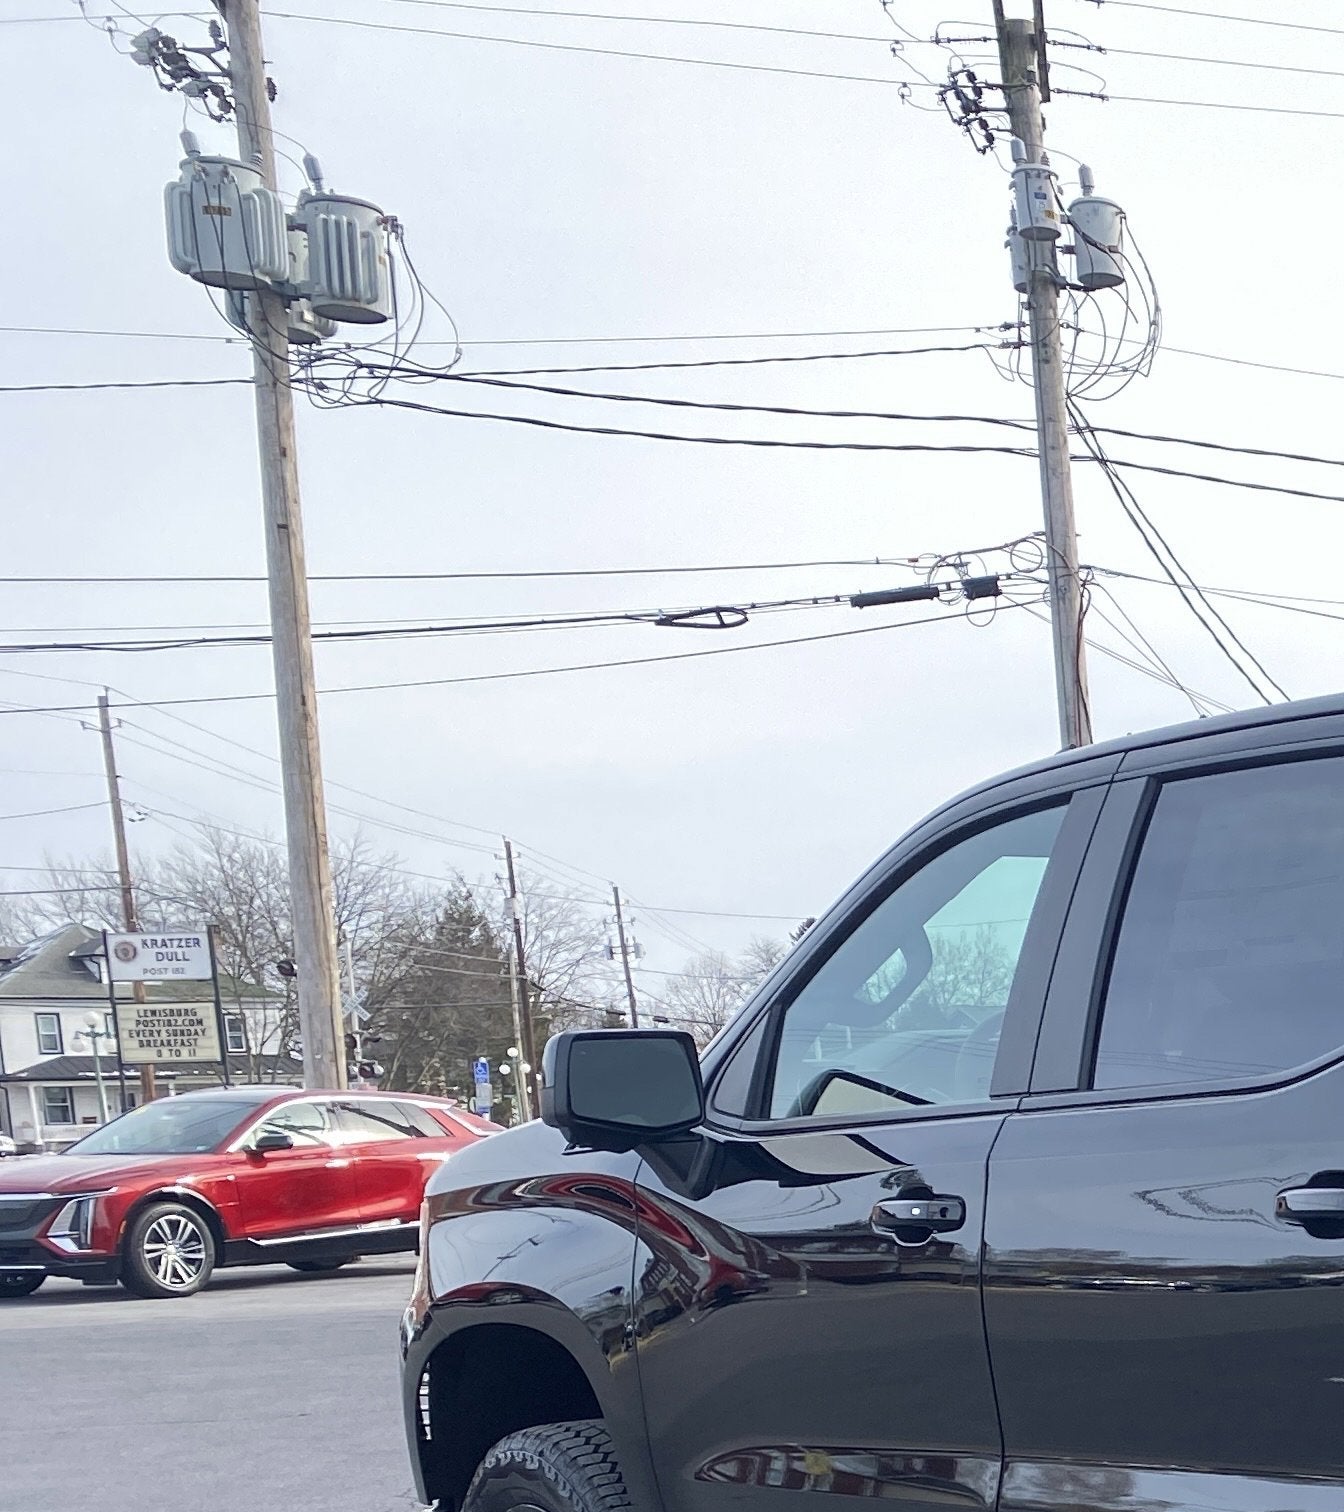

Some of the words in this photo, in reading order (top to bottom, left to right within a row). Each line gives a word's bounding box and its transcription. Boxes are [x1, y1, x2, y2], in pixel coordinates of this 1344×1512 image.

[141, 937, 202, 949] KRATZER
[155, 951, 190, 962] DULL
[142, 967, 169, 976] POST
[136, 1008, 198, 1018] LEWISBURG
[128, 1029, 162, 1039] EVERY
[165, 1027, 207, 1038] SUNDAY
[138, 1038, 199, 1048] BREAKFAST
[168, 1048, 182, 1058] TO
